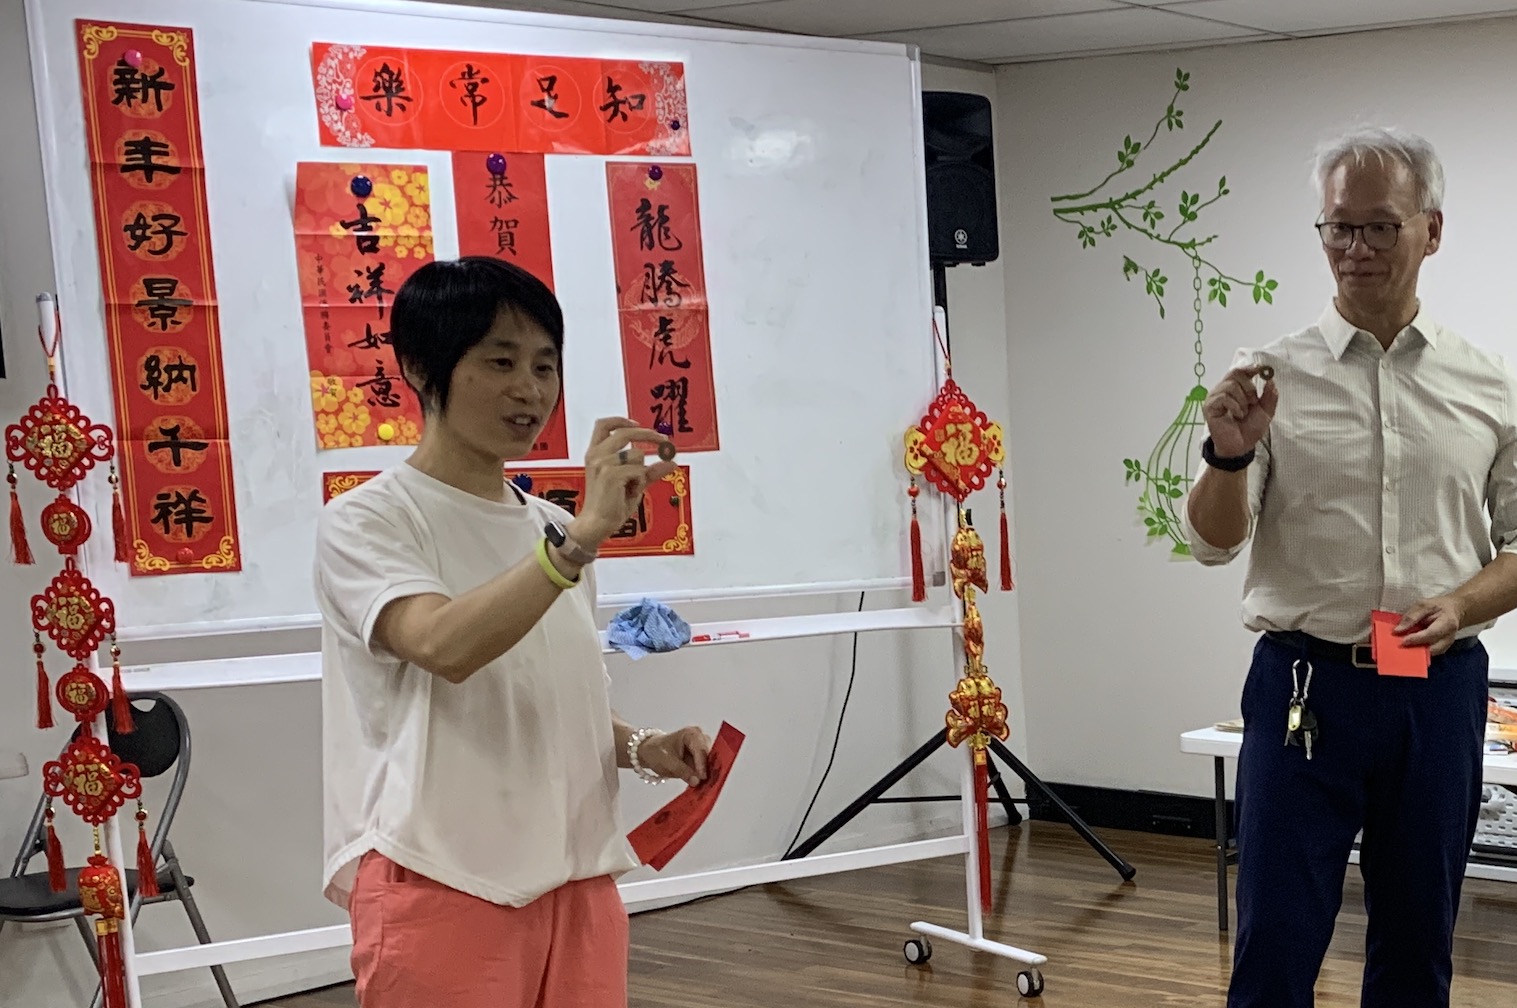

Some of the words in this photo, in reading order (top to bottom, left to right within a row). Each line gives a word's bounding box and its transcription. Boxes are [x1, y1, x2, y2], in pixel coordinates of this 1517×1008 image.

[111, 58, 214, 538] 新年好景納千祥
[339, 202, 402, 408] 吉祥如意
